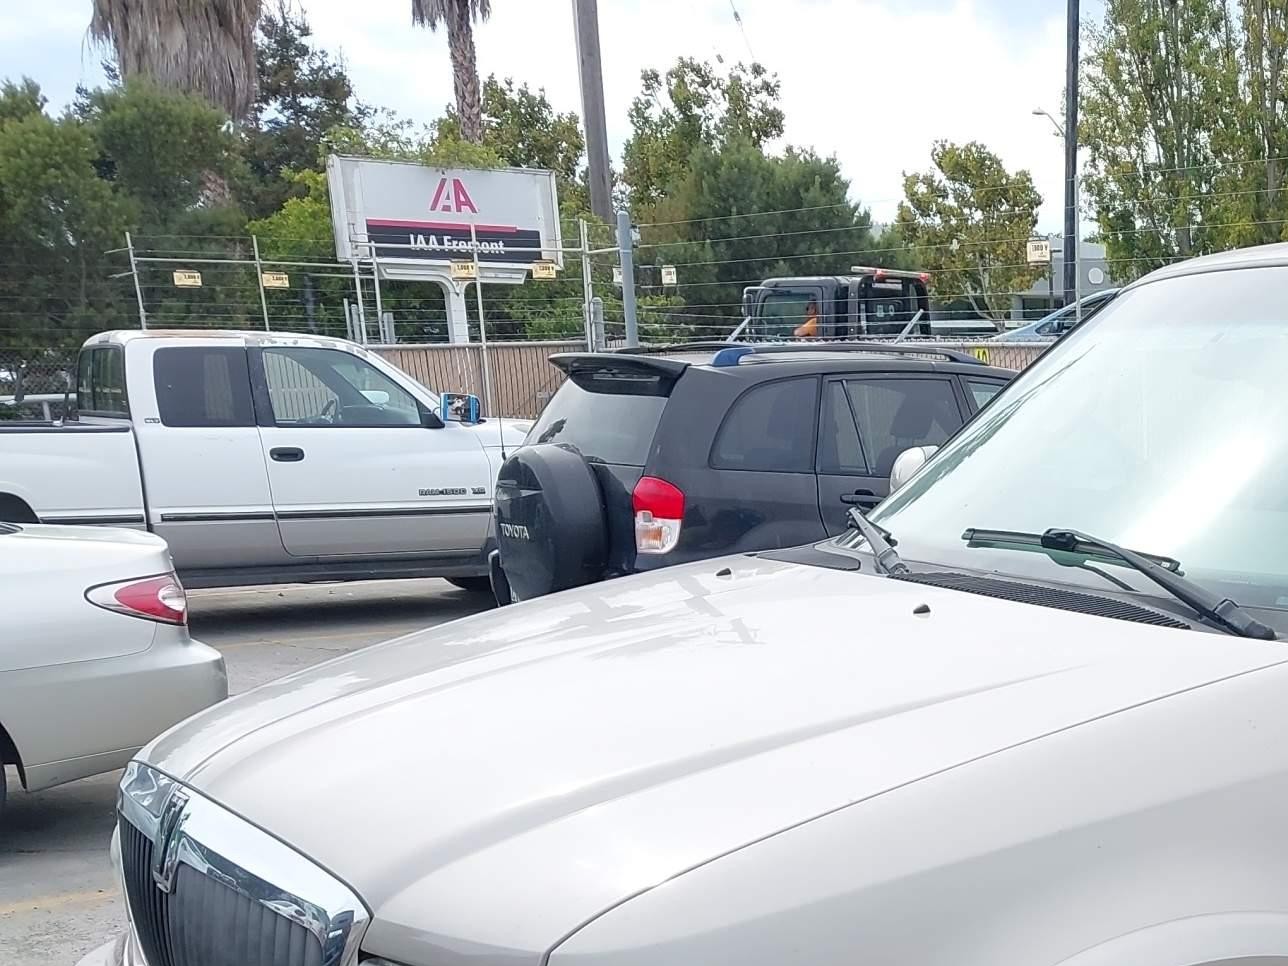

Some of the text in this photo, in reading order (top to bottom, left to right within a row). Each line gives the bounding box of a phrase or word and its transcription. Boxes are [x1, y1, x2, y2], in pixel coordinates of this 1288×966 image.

[409, 233, 505, 254] IAA Fremont
[500, 523, 530, 540] TOYOTA
